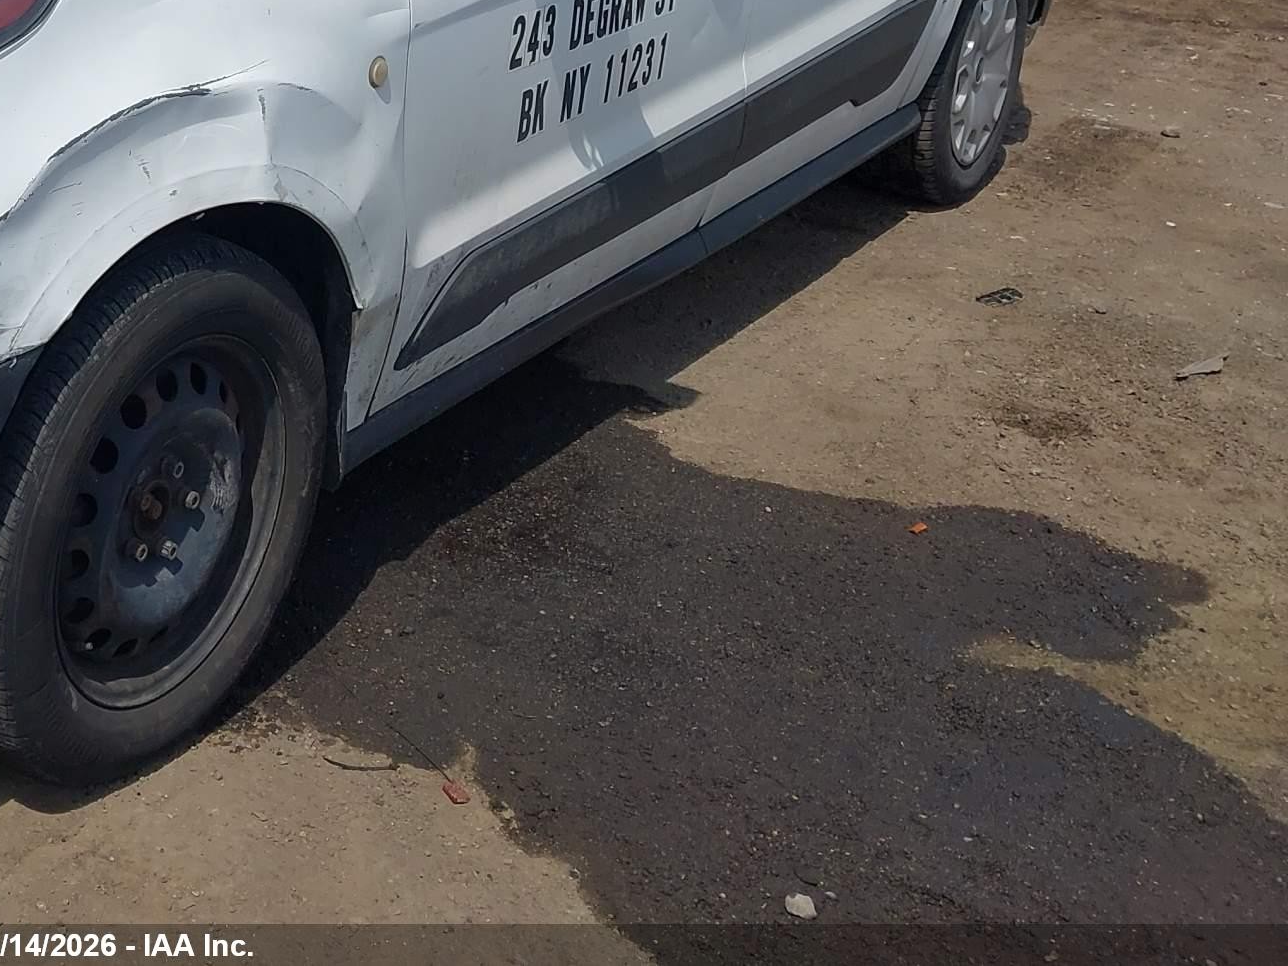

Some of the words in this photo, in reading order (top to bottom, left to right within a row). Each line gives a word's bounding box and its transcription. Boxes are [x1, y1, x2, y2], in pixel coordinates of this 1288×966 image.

[509, 4, 557, 71] 243
[516, 79, 550, 144] BK
[559, 63, 592, 123] NY
[603, 32, 668, 104] 11231
